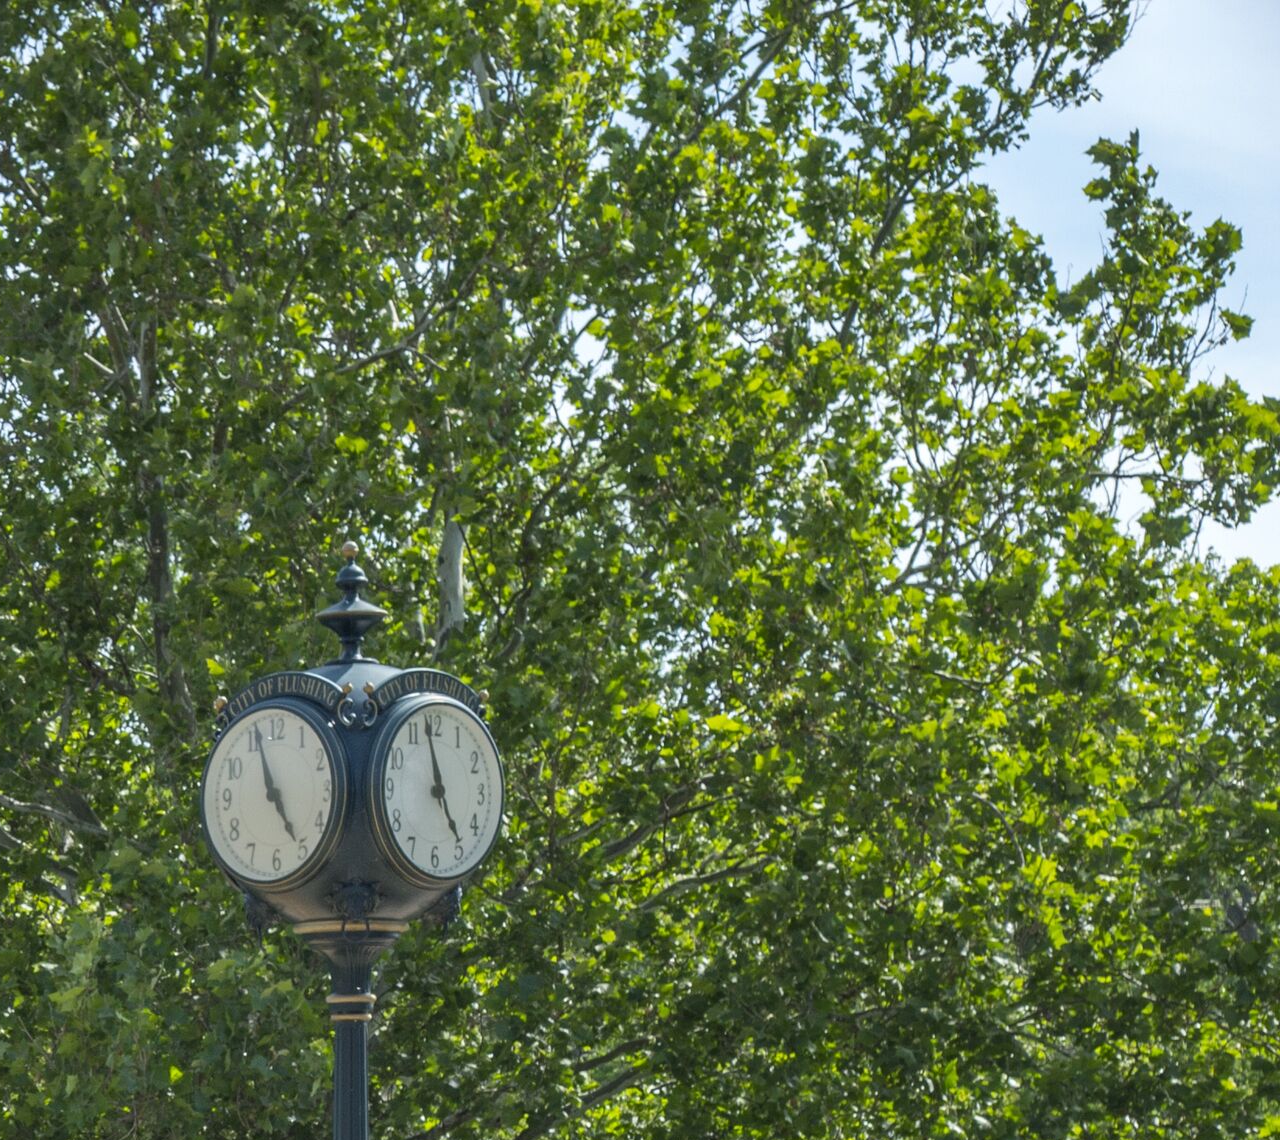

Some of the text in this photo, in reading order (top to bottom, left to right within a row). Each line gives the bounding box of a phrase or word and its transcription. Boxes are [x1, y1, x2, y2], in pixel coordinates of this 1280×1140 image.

[229, 674, 338, 716] CITY OF FLUSHING
[378, 672, 478, 713] CITY OF FLUSHING
[269, 718, 286, 741] 12
[408, 722, 419, 745] 11
[224, 757, 243, 780] 10
[315, 748, 325, 771] 2
[390, 747, 404, 770] 10
[470, 751, 479, 774] 2
[223, 788, 232, 811] 9
[322, 779, 331, 803] 3
[386, 777, 394, 800] 9
[477, 783, 485, 806] 3
[229, 818, 240, 841] 8
[314, 810, 325, 834] 4
[392, 809, 401, 832] 8
[470, 813, 479, 837] 4
[247, 843, 256, 866] 7
[272, 848, 282, 871] 6
[297, 838, 308, 861] 5
[407, 836, 416, 860] 7
[431, 845, 440, 868] 6
[453, 836, 464, 860] 5
